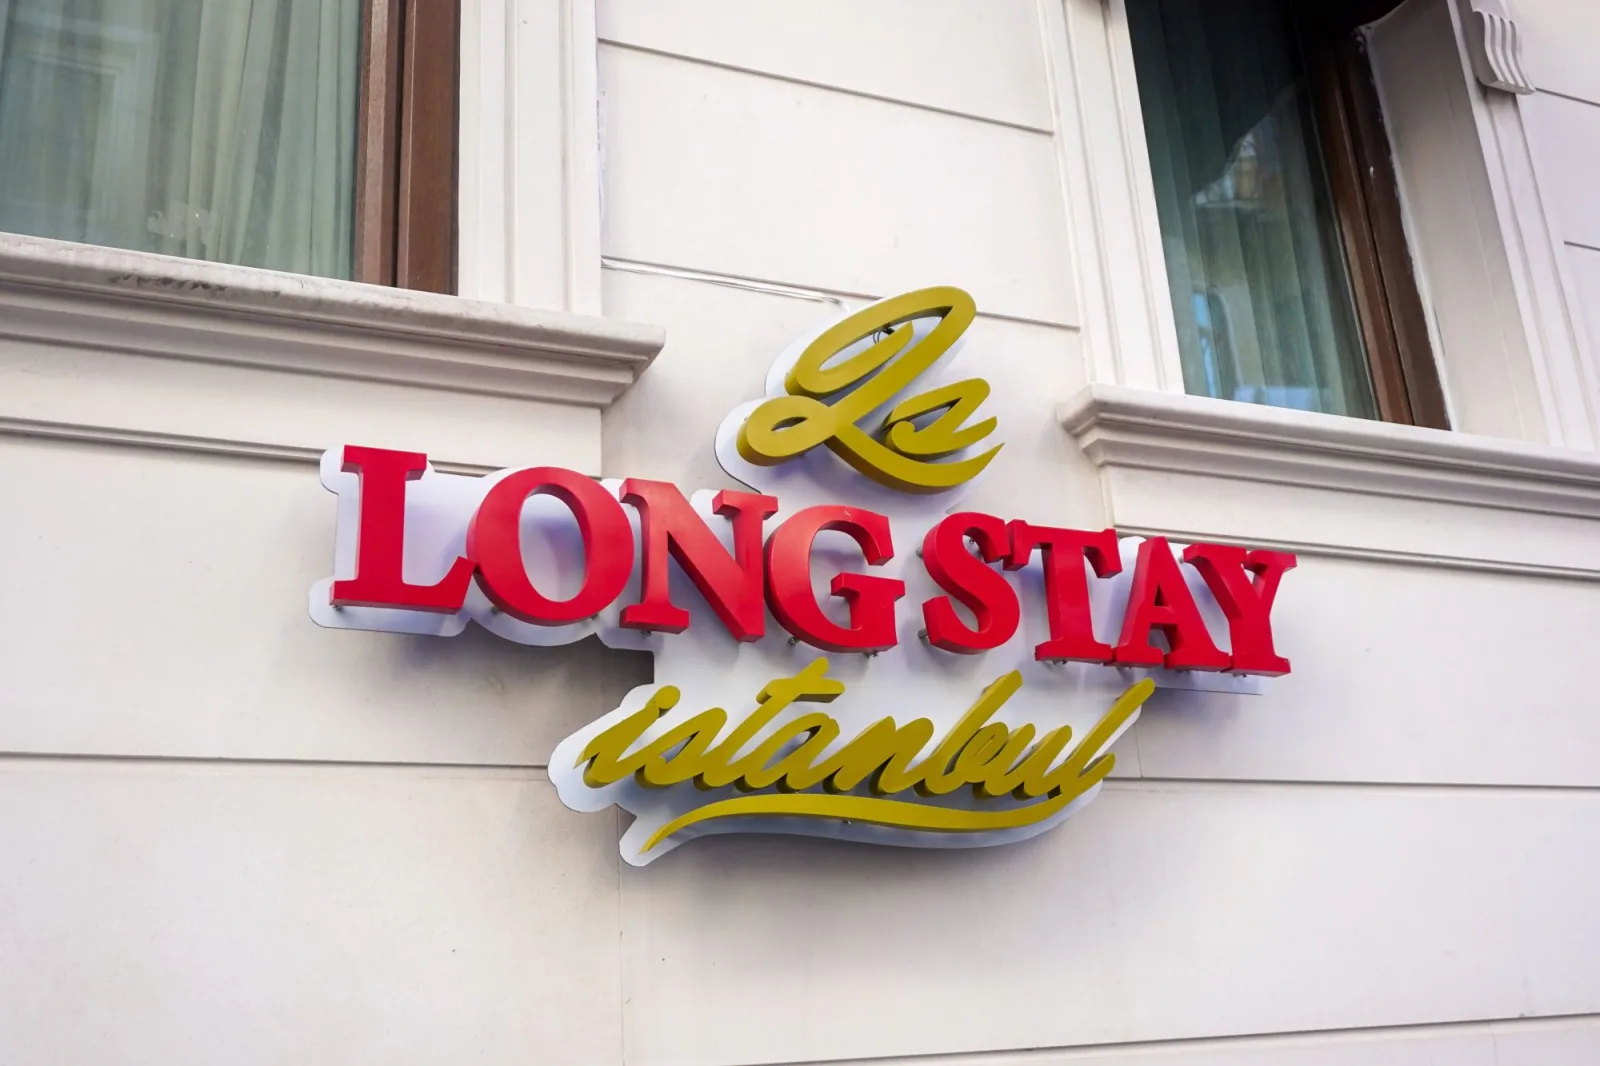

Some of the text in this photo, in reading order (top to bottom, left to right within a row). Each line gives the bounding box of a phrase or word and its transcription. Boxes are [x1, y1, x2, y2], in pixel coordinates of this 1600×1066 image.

[737, 286, 1004, 494] Le
[330, 444, 1298, 677] LONG STAY
[575, 656, 1156, 812] istanbul
